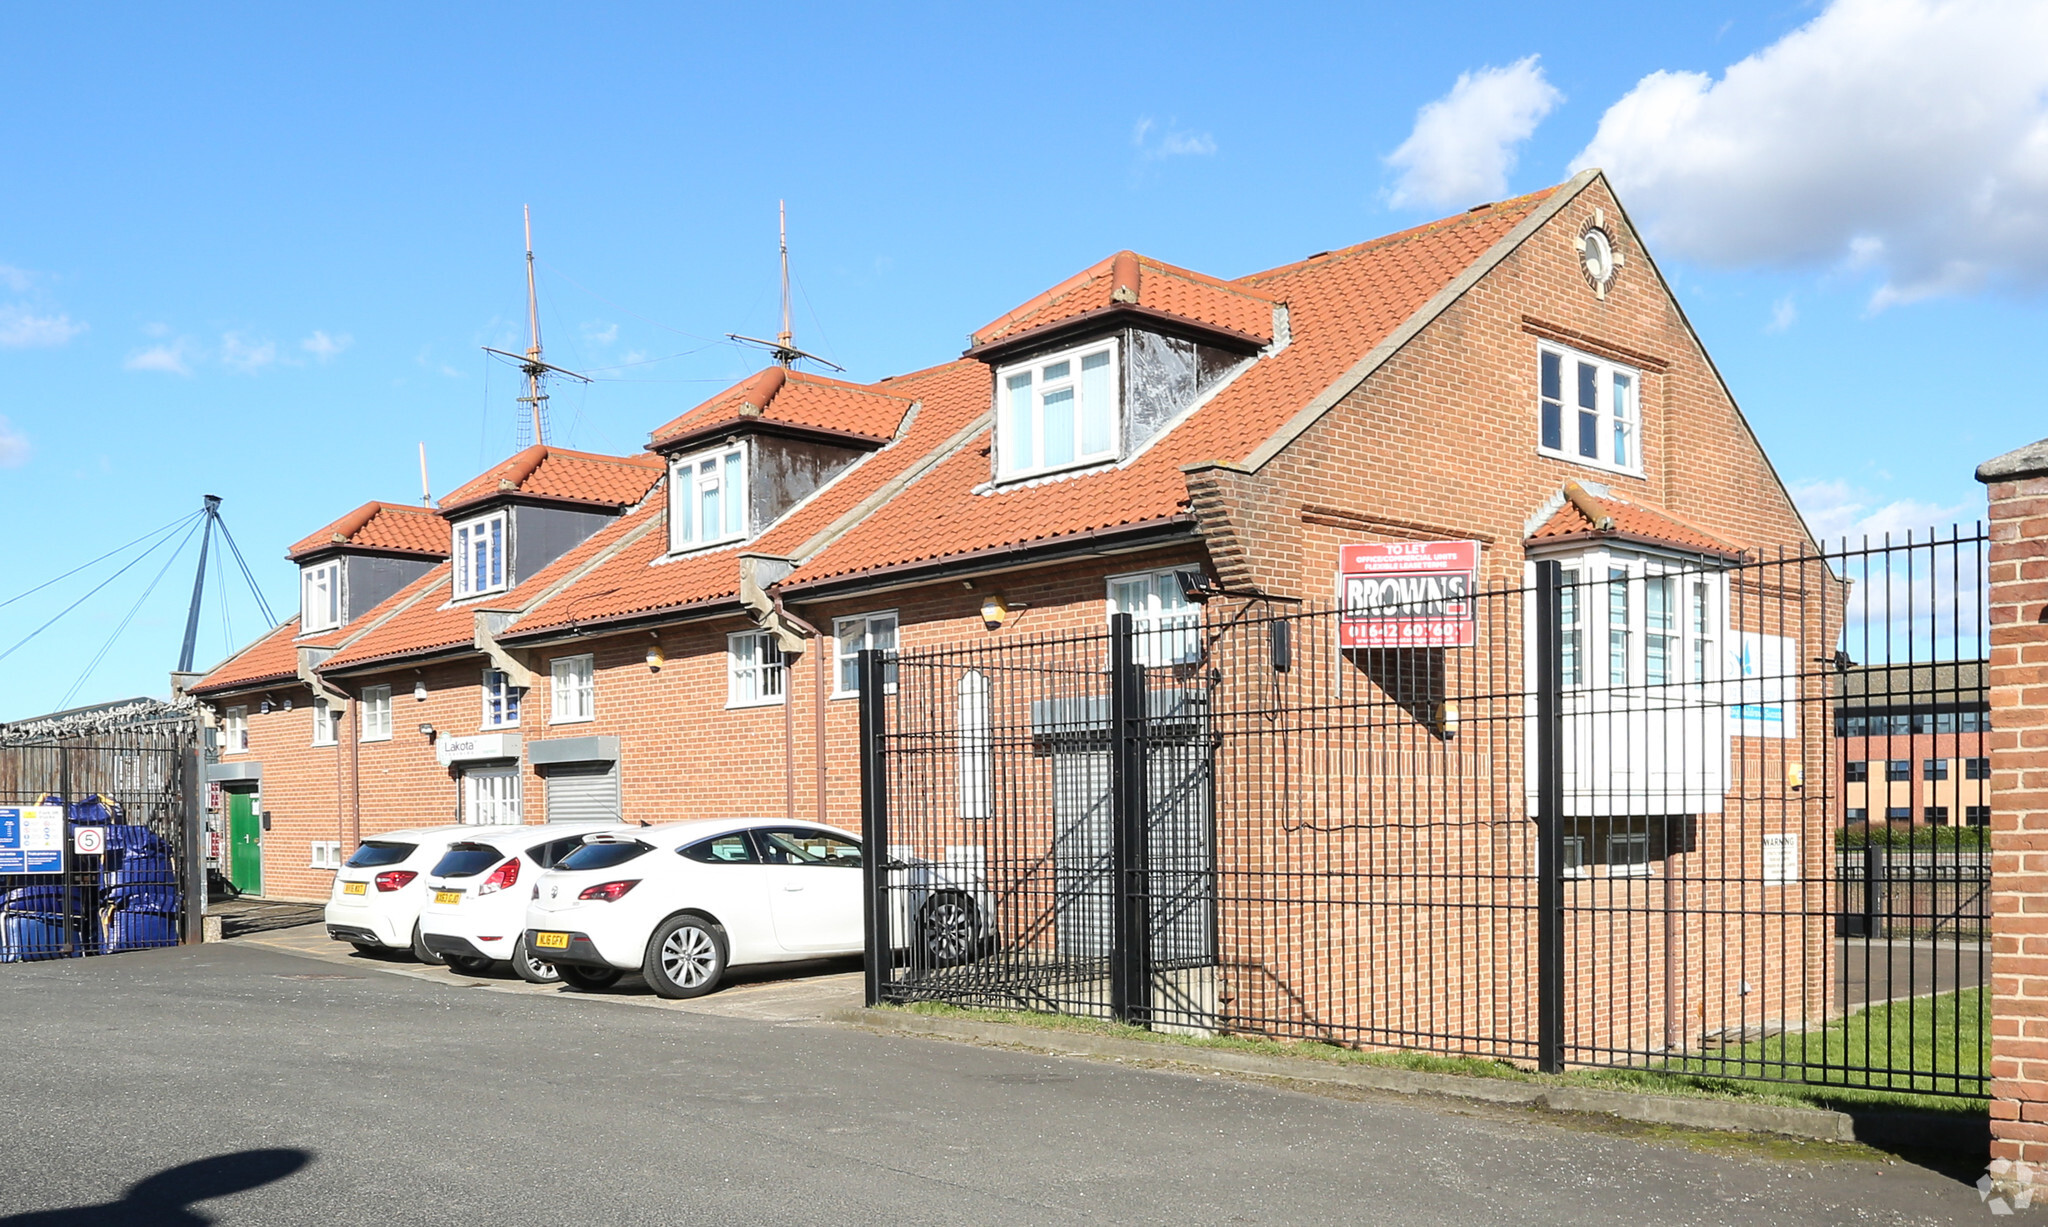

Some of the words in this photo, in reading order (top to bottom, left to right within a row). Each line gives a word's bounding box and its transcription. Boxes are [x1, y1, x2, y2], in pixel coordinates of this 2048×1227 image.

[1386, 544, 1403, 555] TO
[1405, 543, 1428, 554] LET
[1434, 552, 1458, 561] UNITS
[1364, 562, 1398, 570] FLEXIBLE
[1400, 561, 1423, 569] LEASE
[1347, 576, 1465, 616] BROWNS
[1348, 624, 1398, 638] 01642
[1402, 623, 1464, 636] 607607
[444, 741, 474, 752] Lakota
[85, 834, 94, 847] 5
[1762, 837, 1795, 846] WARNNG
